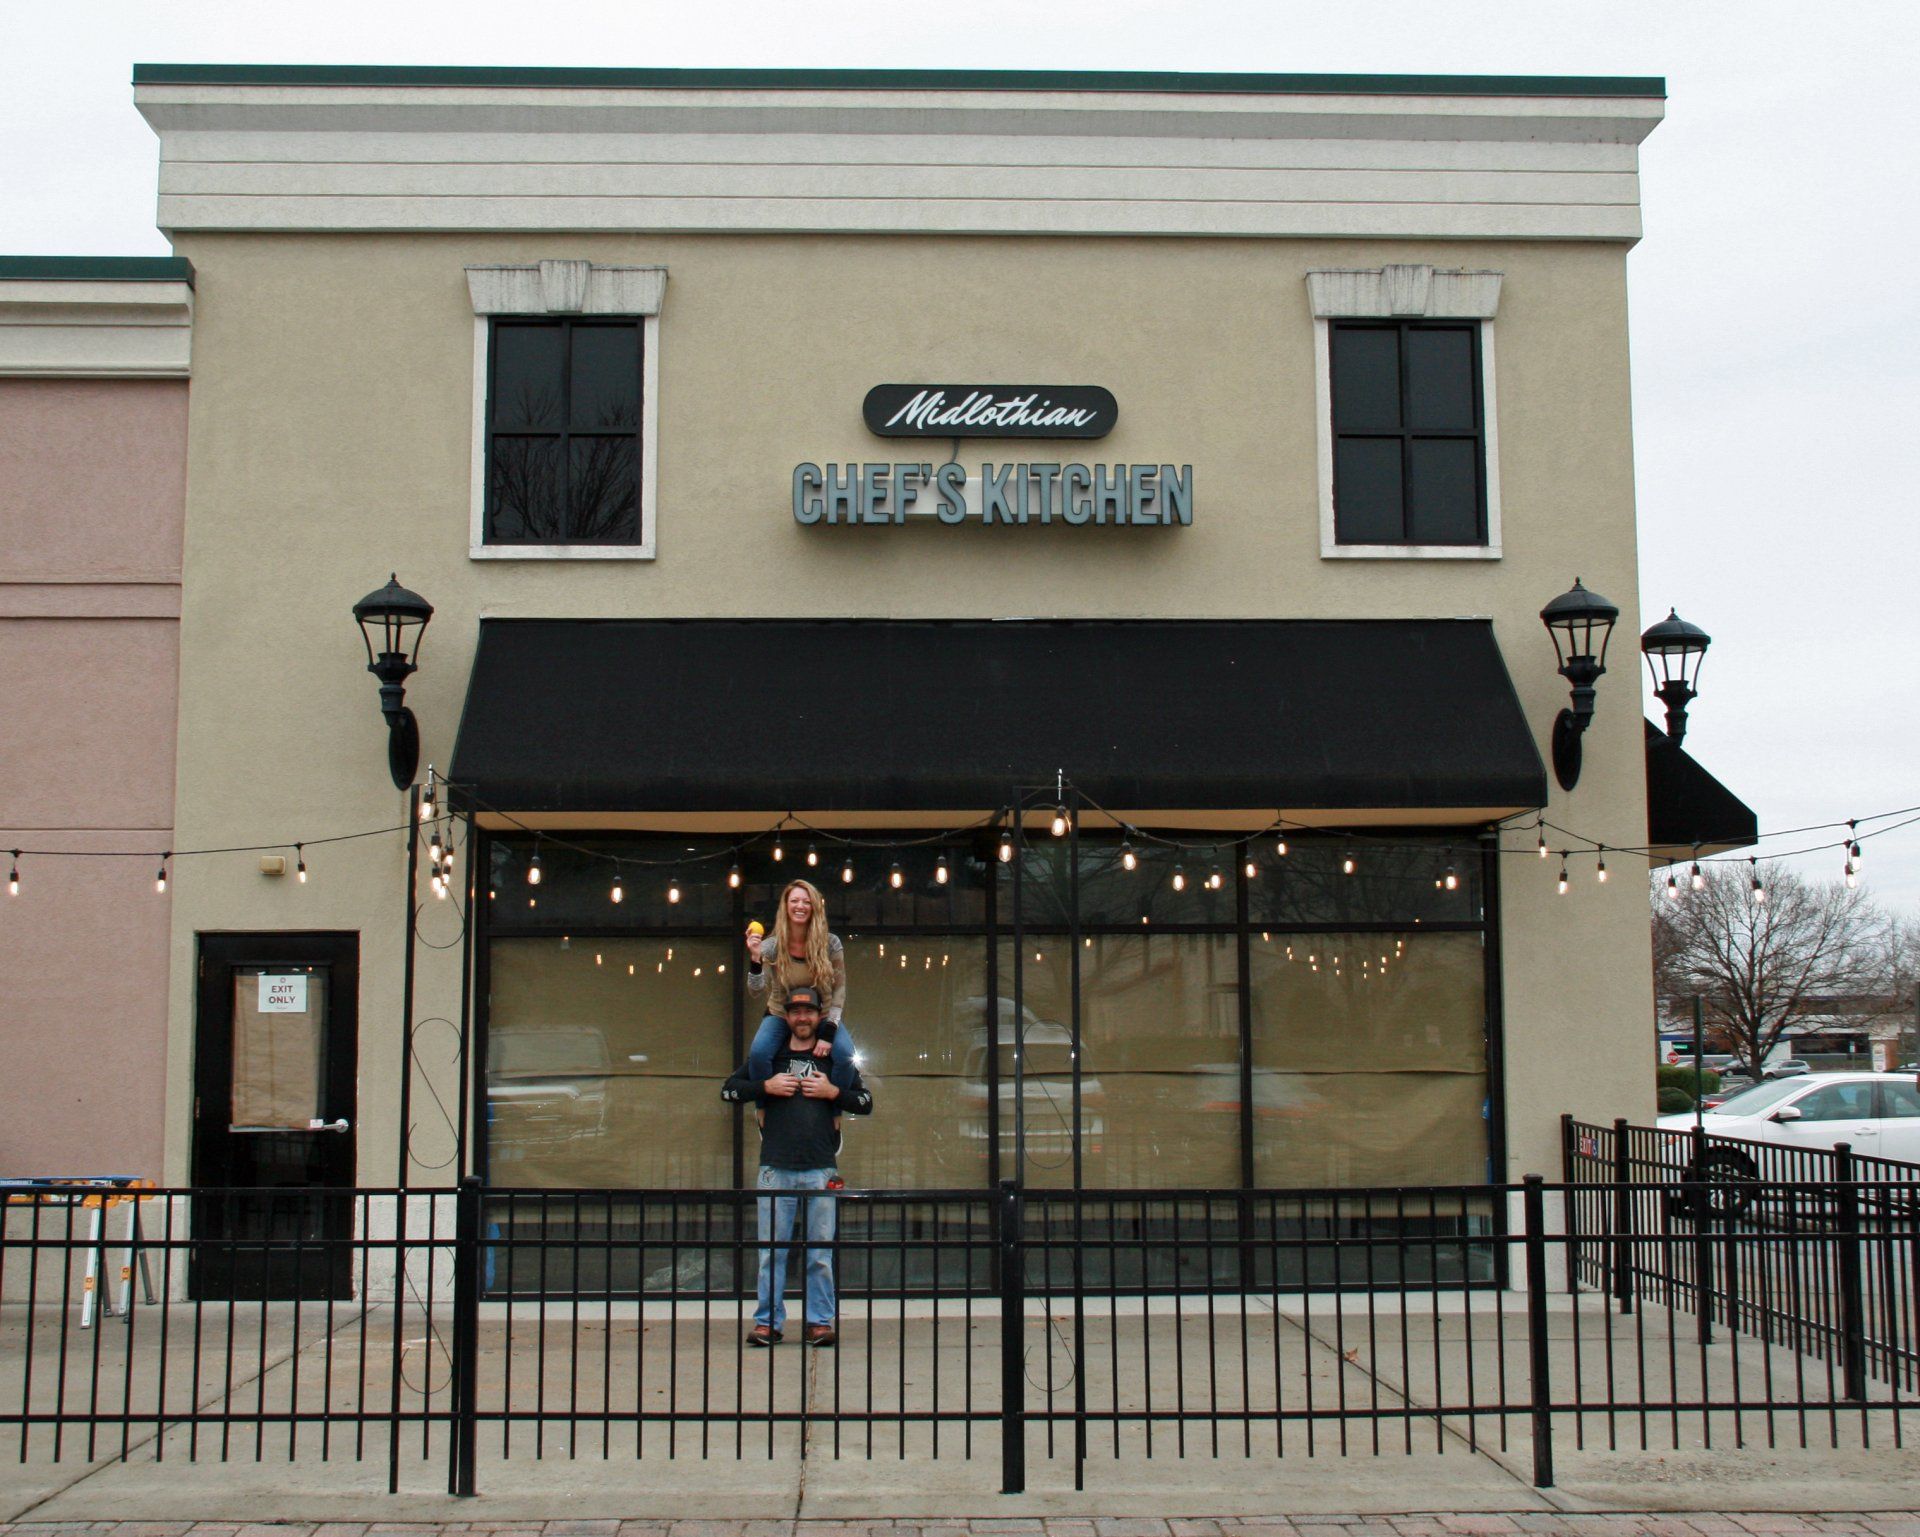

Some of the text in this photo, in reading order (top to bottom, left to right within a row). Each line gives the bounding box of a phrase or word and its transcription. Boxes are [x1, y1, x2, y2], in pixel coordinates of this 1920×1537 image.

[885, 390, 1098, 430] Midlothian
[792, 462, 1193, 526] CHEF'S KITCHEN
[268, 996, 296, 1004] ONLY
[271, 985, 293, 993] EXIT
